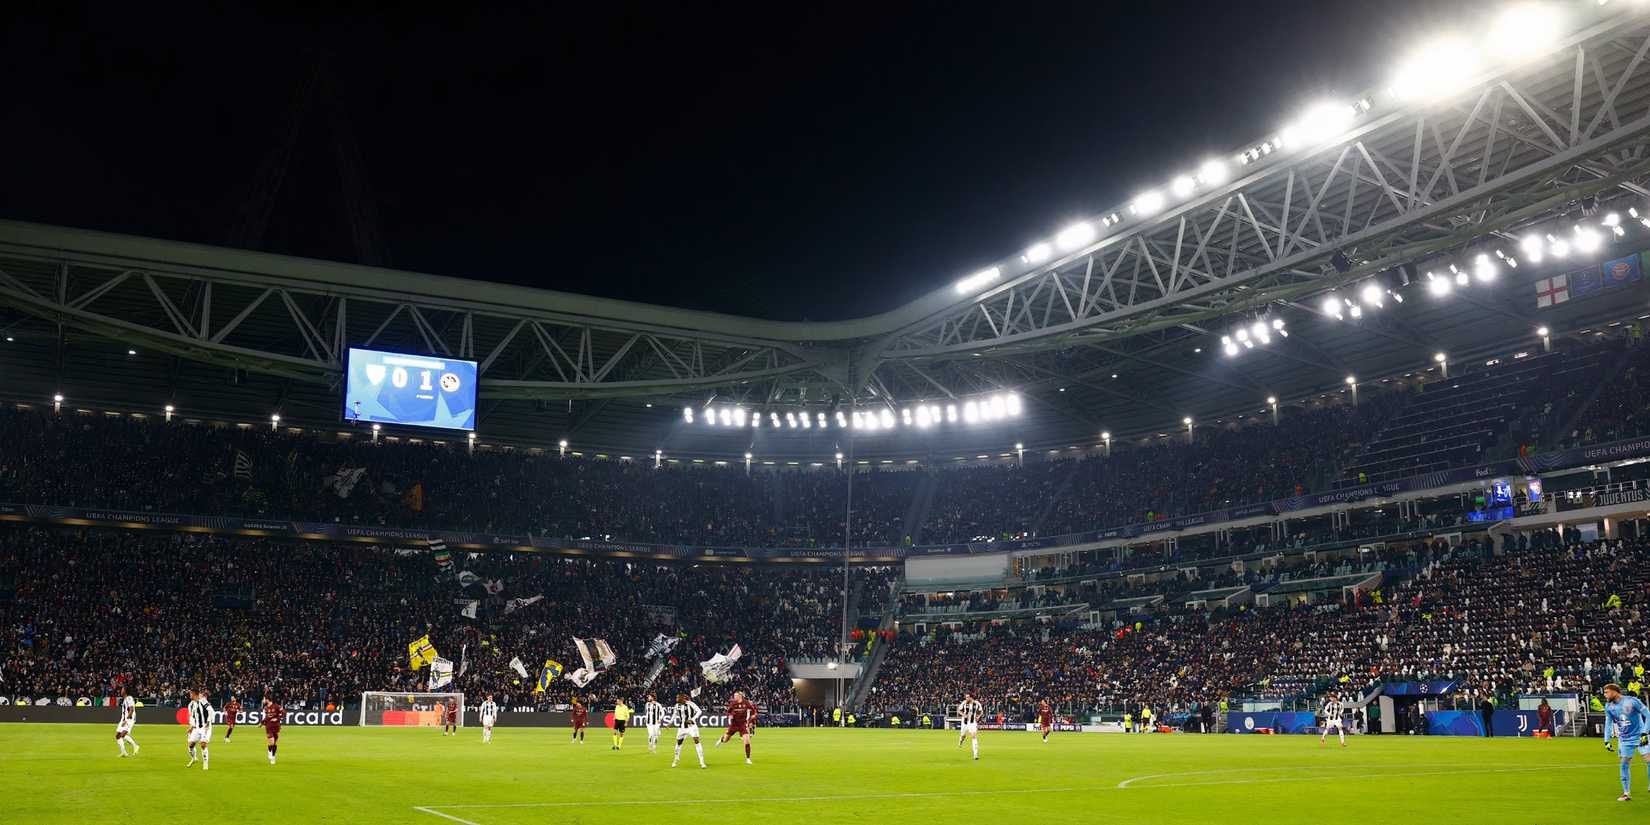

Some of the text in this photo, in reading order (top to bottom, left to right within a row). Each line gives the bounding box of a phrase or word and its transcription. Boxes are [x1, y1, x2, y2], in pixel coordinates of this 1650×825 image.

[392, 367, 433, 391] 0 1
[1584, 447, 1608, 458] UEFA
[1318, 494, 1336, 504] UEFA
[1599, 489, 1644, 506] JUVENTUS
[86, 512, 105, 521] UEFA
[107, 513, 150, 523] CHAMPIONS
[346, 528, 366, 537] UEFA
[367, 530, 404, 539] CHAMPIONS
